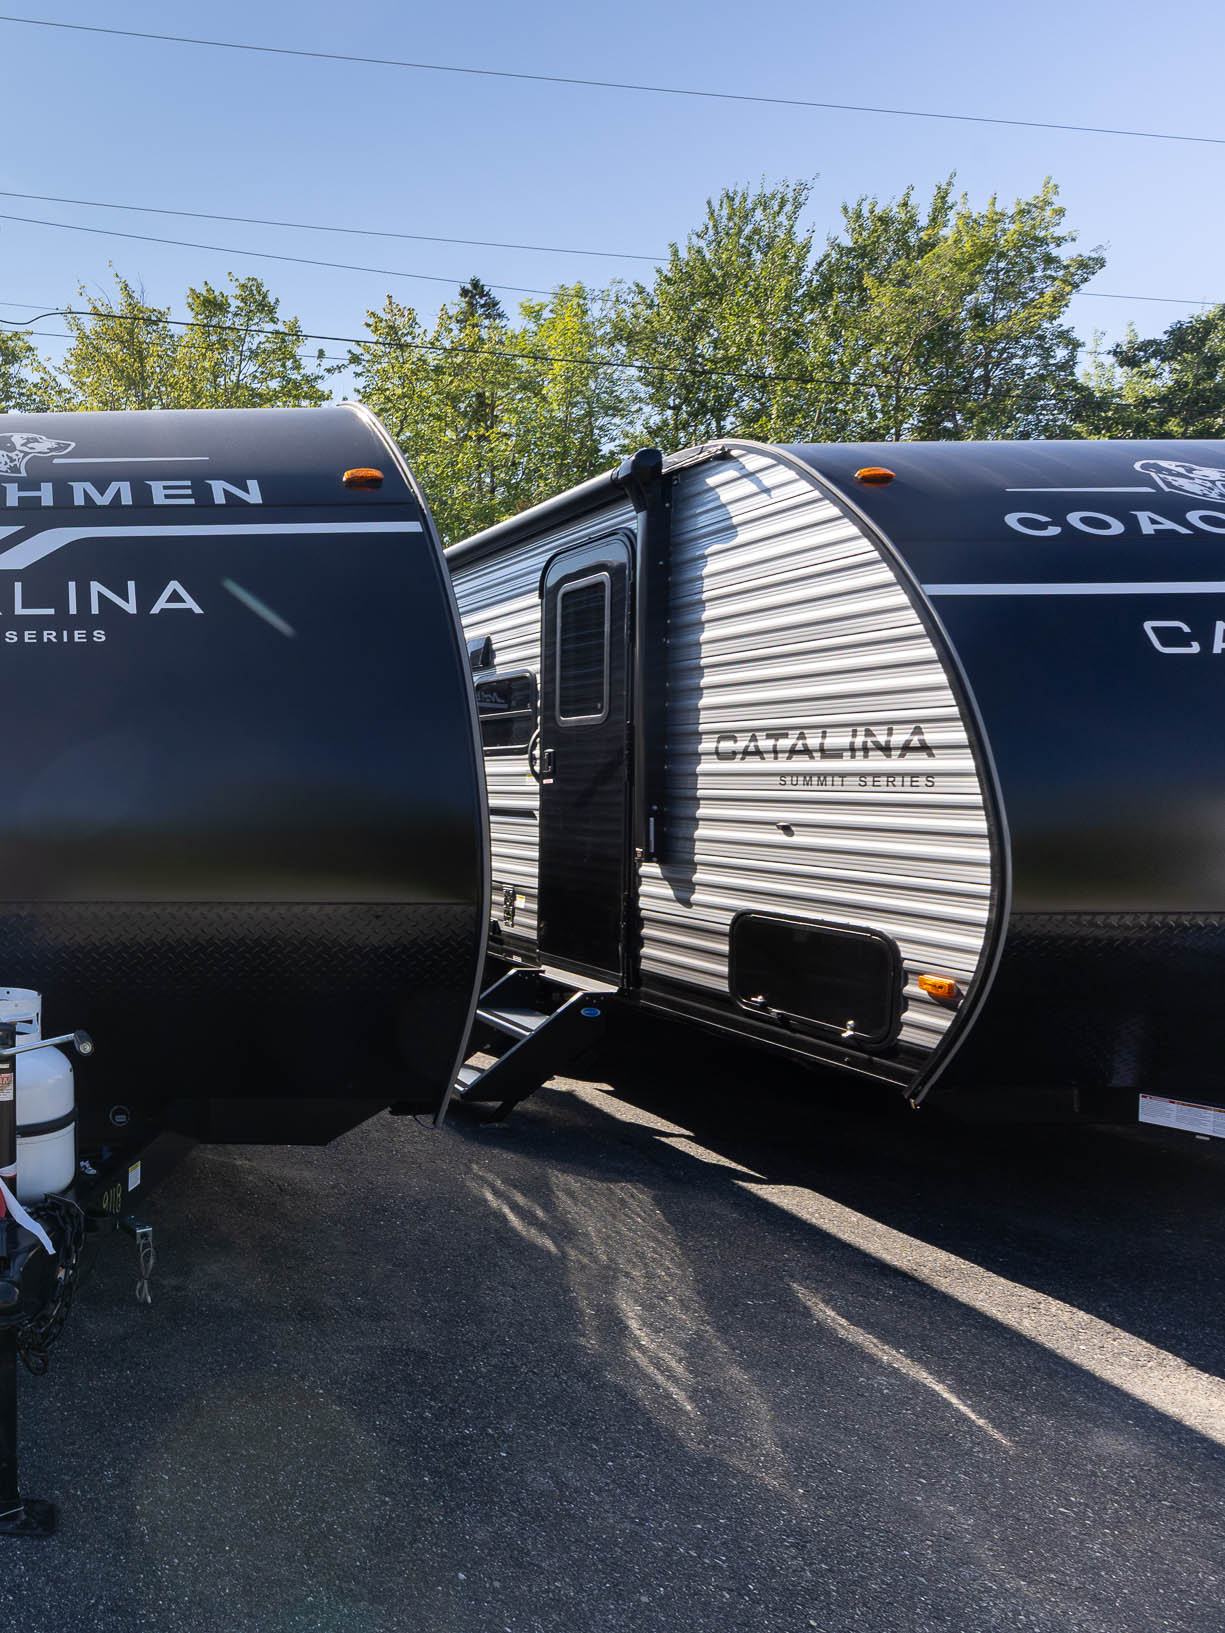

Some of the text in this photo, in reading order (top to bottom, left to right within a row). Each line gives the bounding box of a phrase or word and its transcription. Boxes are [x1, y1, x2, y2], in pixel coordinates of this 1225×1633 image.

[4, 629, 108, 644] SERIES
[714, 725, 936, 761] CATALINA
[778, 775, 936, 788] SUMMIT SERIES
